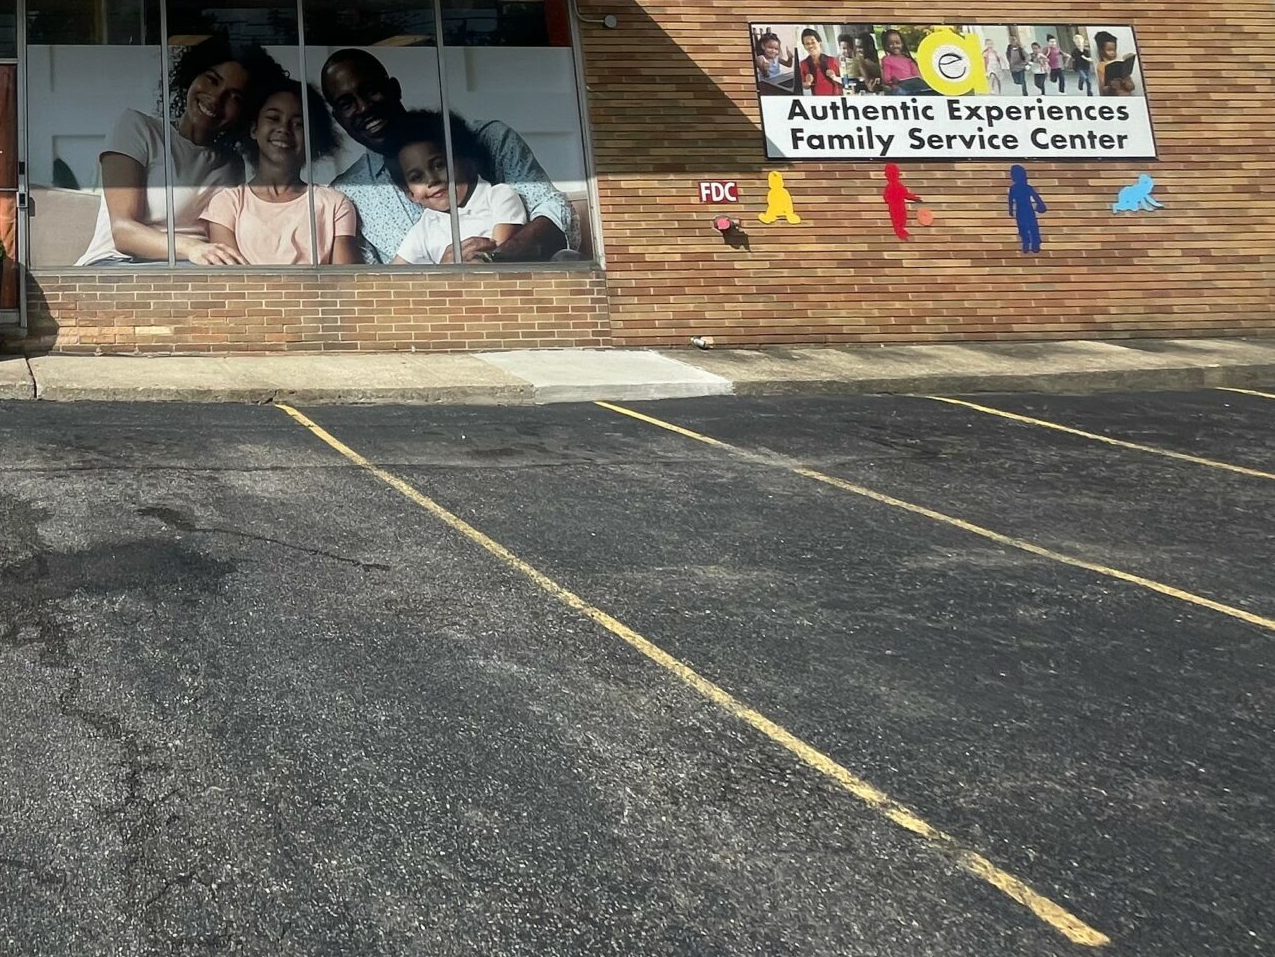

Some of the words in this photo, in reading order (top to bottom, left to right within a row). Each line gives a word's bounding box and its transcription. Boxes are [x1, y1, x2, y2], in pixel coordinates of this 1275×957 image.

[788, 97, 935, 121] Authentic
[947, 99, 1130, 127] Experiences
[790, 126, 895, 156] Family
[908, 127, 1019, 150] Service
[1031, 128, 1128, 150] Center
[700, 182, 737, 201] FDC
